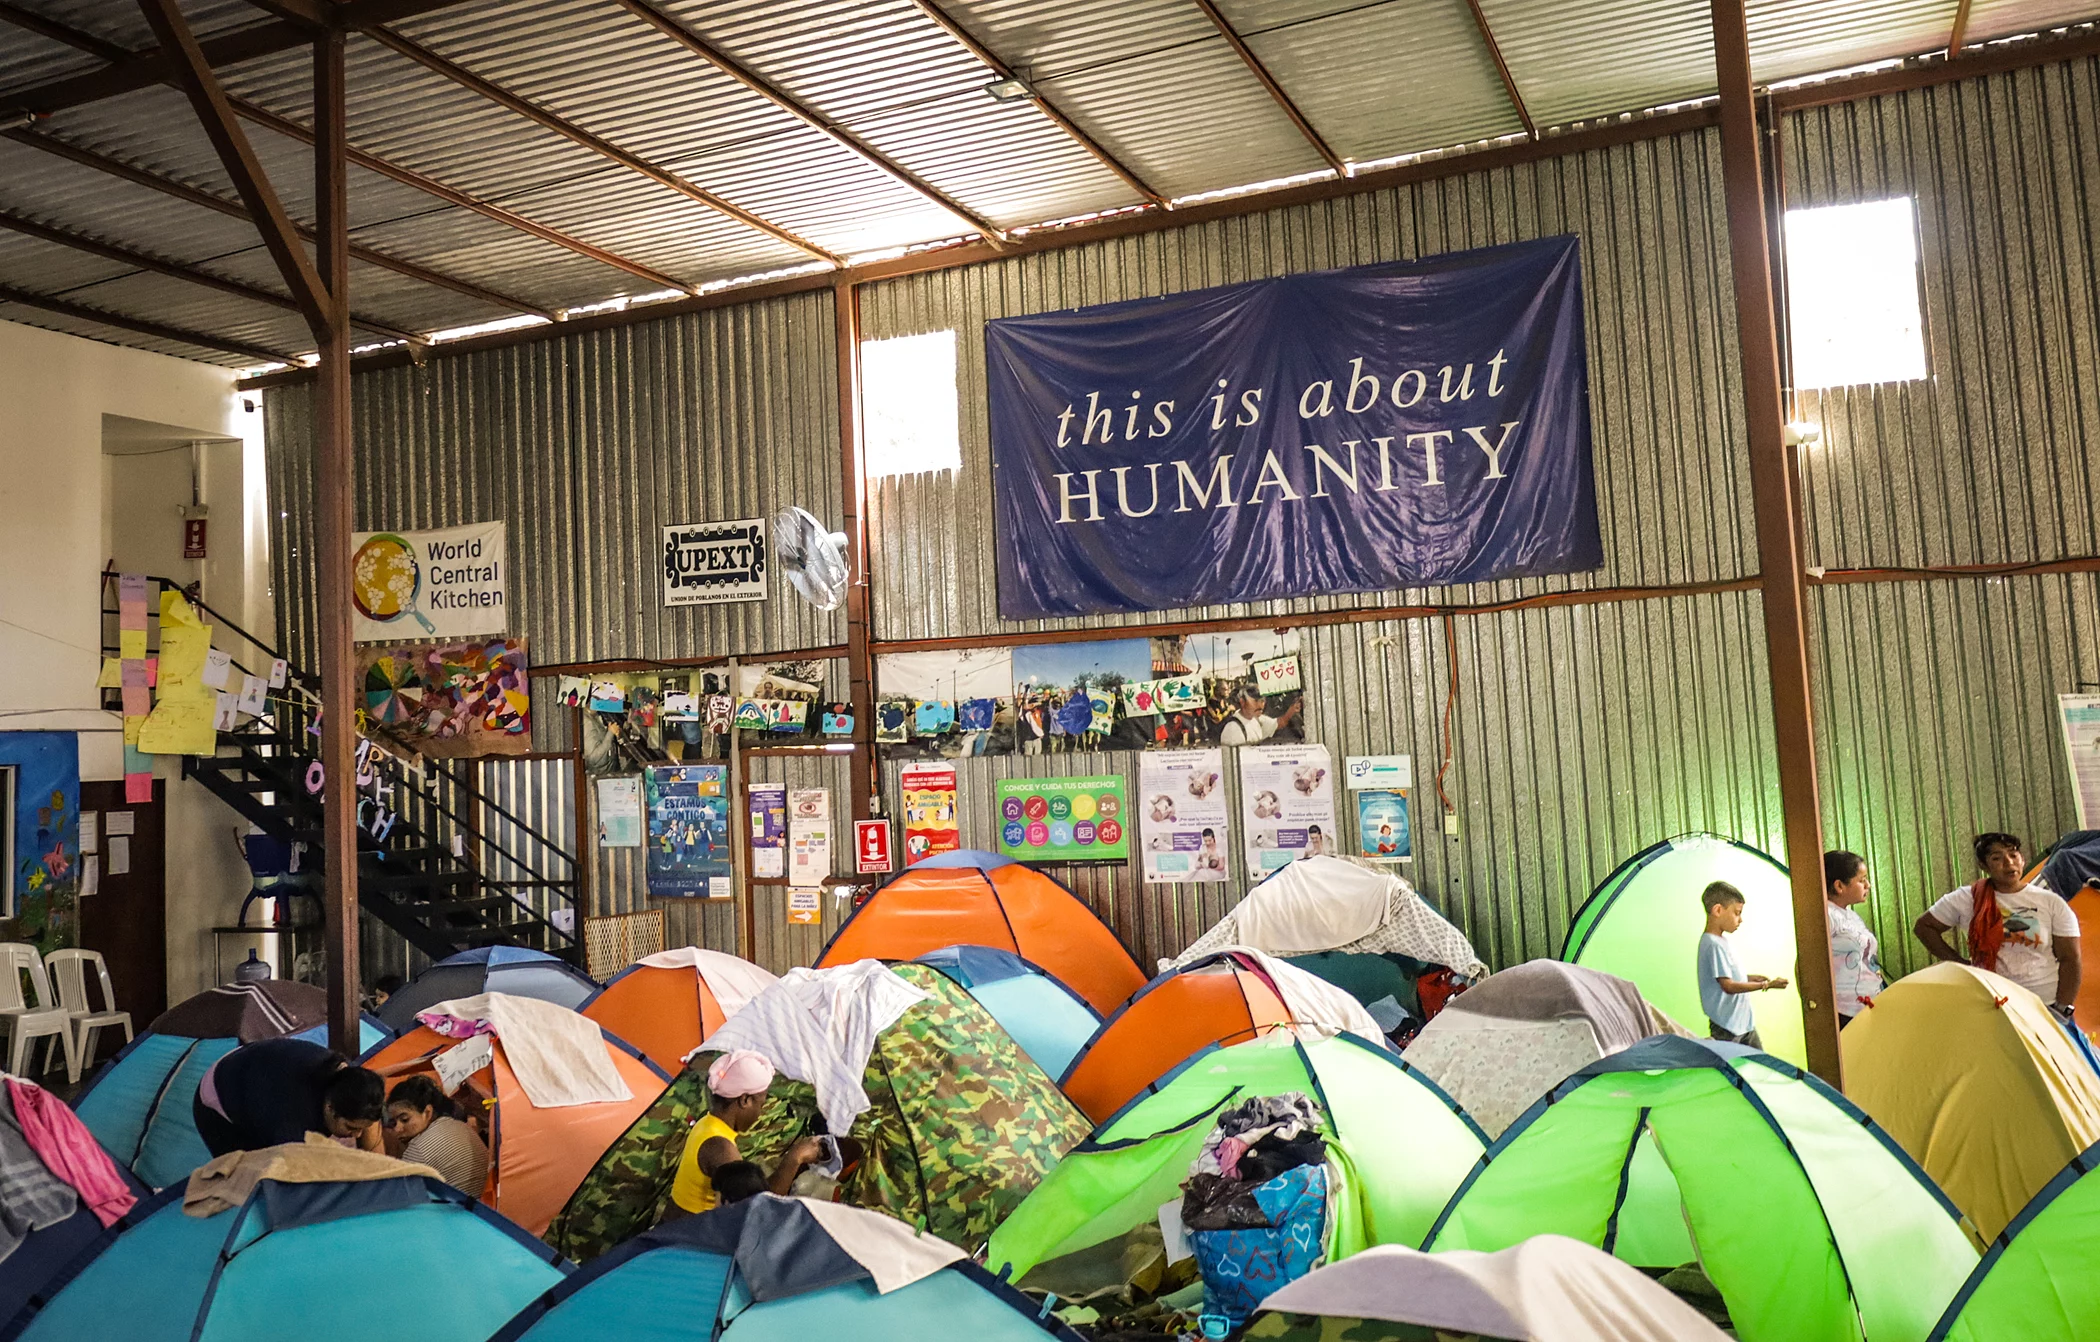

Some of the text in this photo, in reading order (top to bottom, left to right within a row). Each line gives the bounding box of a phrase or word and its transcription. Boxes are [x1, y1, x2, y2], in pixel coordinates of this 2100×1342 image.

[1056, 348, 1507, 449] this is about
[1053, 421, 1519, 524] HUMANITY
[428, 538, 482, 561] World
[676, 544, 752, 573] UPEXT
[430, 562, 498, 585] Central
[430, 588, 503, 609] Kitchen
[1004, 783, 1034, 791] CONOCE
[1063, 782, 1077, 790] TUS
[1077, 781, 1116, 789] DERECHOS
[664, 798, 706, 809] ESTAMOS
[862, 863, 888, 871] EXTINTOR
